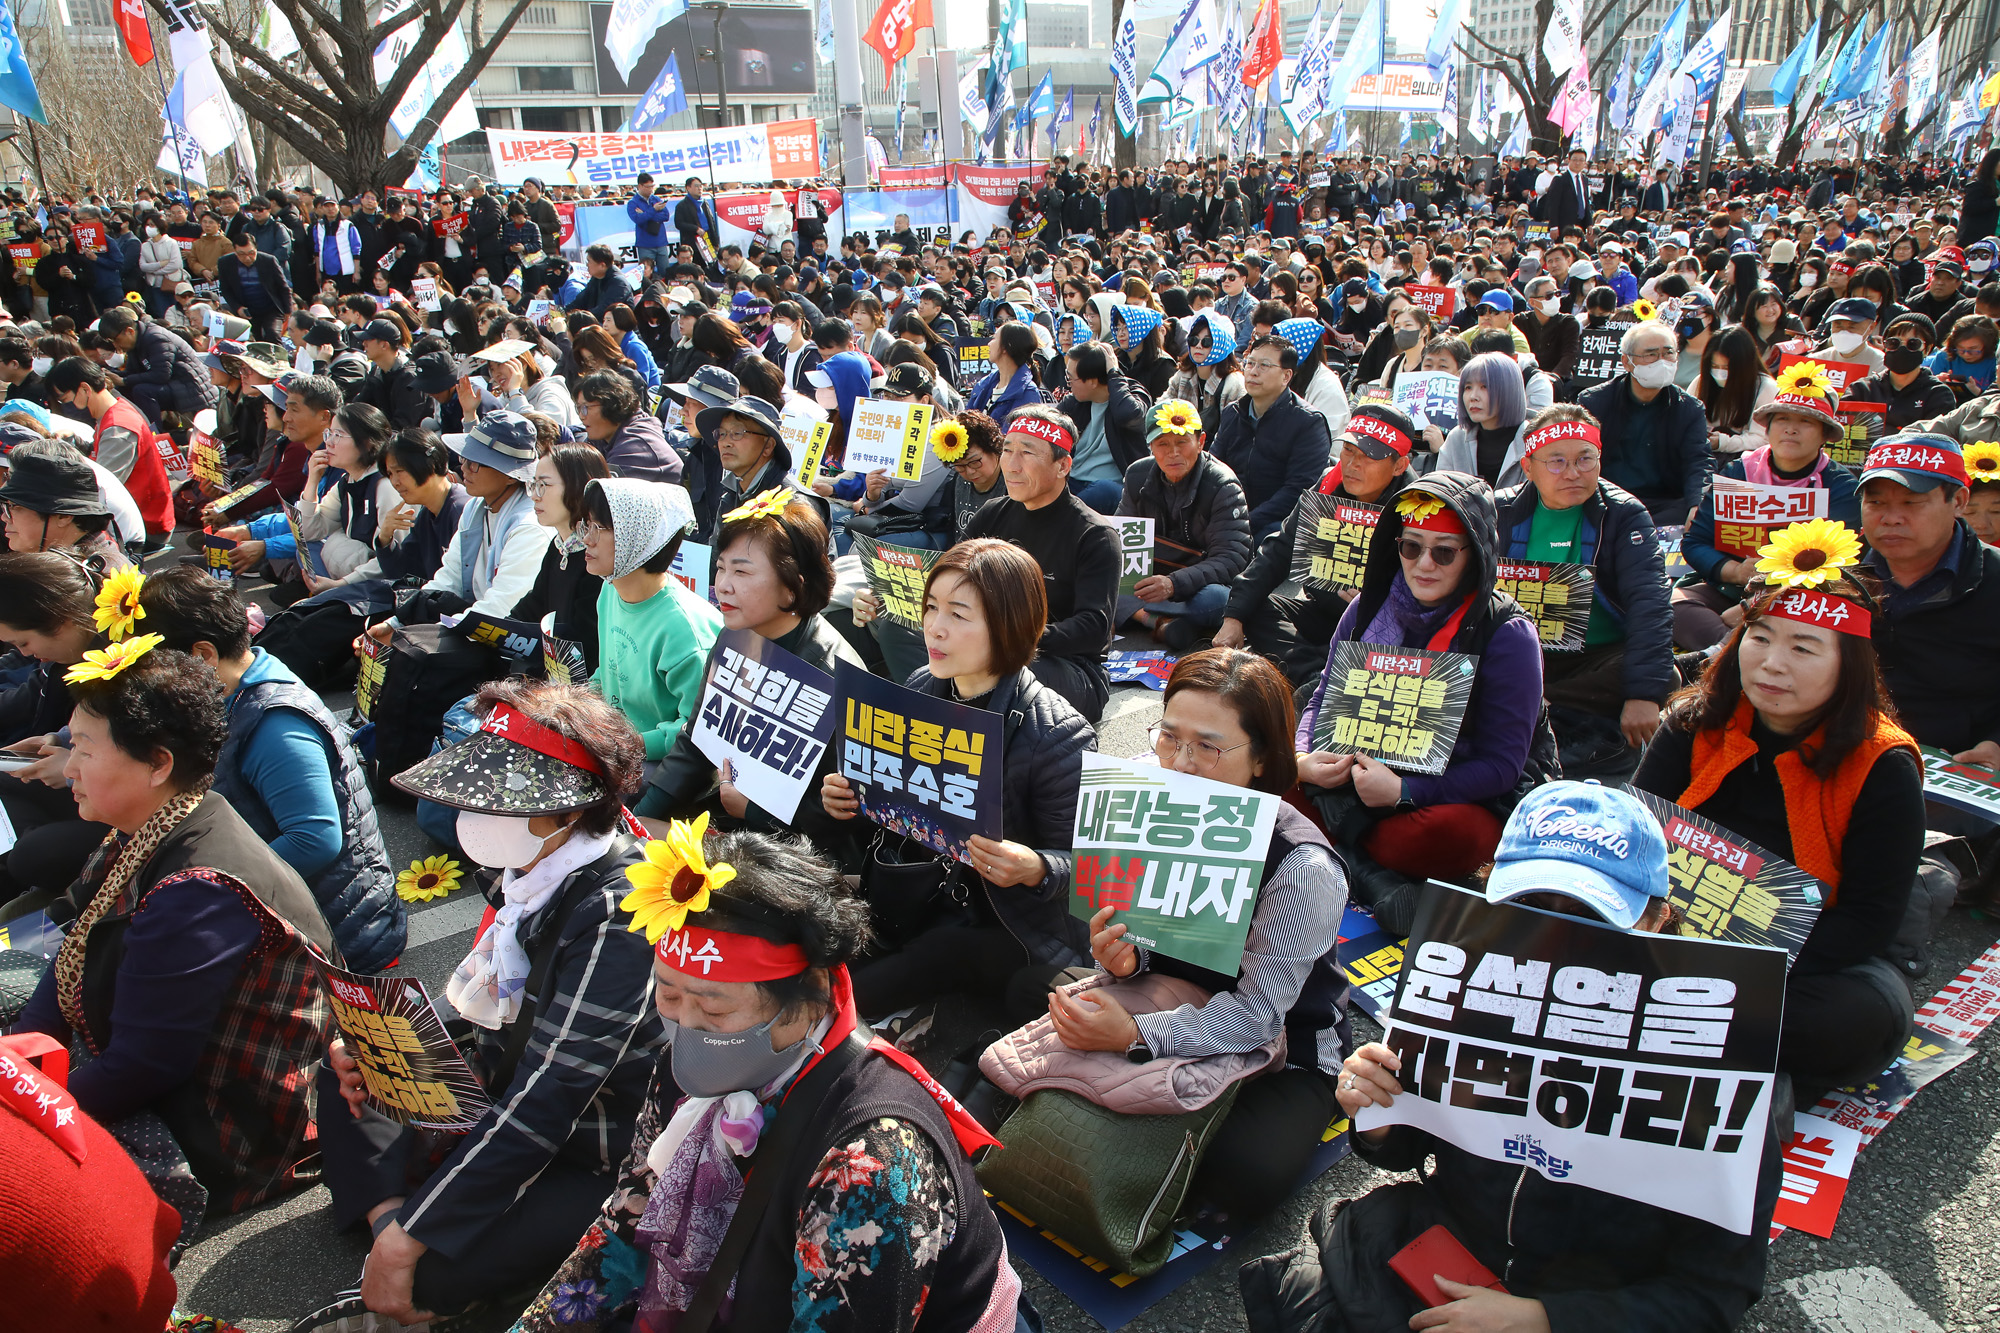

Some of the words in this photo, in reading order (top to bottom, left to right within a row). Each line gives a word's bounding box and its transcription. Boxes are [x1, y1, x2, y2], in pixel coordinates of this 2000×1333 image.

[772, 133, 812, 151] 진보당
[586, 149, 683, 182] 농민헌법
[727, 204, 759, 216] SK텔레콤
[960, 345, 980, 361] 내란
[1582, 335, 1618, 355] 헌재는
[960, 360, 980, 375] 민주
[1577, 358, 1613, 380] 분노를
[855, 427, 885, 444] 따르라!
[858, 410, 884, 427] 국민의
[885, 413, 903, 430] 뜻을
[1714, 490, 1817, 521] 내란수괴
[1370, 654, 1422, 675] 내란수괴
[712, 646, 832, 733] 김건희를
[1343, 668, 1448, 711] 윤석열을
[702, 692, 823, 781] 수사하라!
[844, 696, 906, 757] 내란
[908, 716, 986, 777] 종식
[1332, 716, 1435, 760] 파면하라
[844, 738, 907, 794] 민주
[907, 763, 980, 821] 수호
[1077, 789, 1262, 853] 내란농정
[1539, 840, 1604, 861] ORIGINAL
[1672, 822, 1749, 872] 내란수괴
[1075, 854, 1254, 925] 박살내자
[1668, 846, 1782, 932] 석열을
[331, 977, 372, 1008] 내란수괴
[1397, 940, 1738, 1060] 윤석열을
[329, 994, 426, 1054] 윤석열을
[703, 1036, 730, 1048] Copper
[355, 1057, 464, 1117] 파면하라
[1386, 1026, 1765, 1154] 파면하라!
[1503, 1138, 1573, 1179] 민주당
[1514, 1133, 1542, 1147] 더불어
